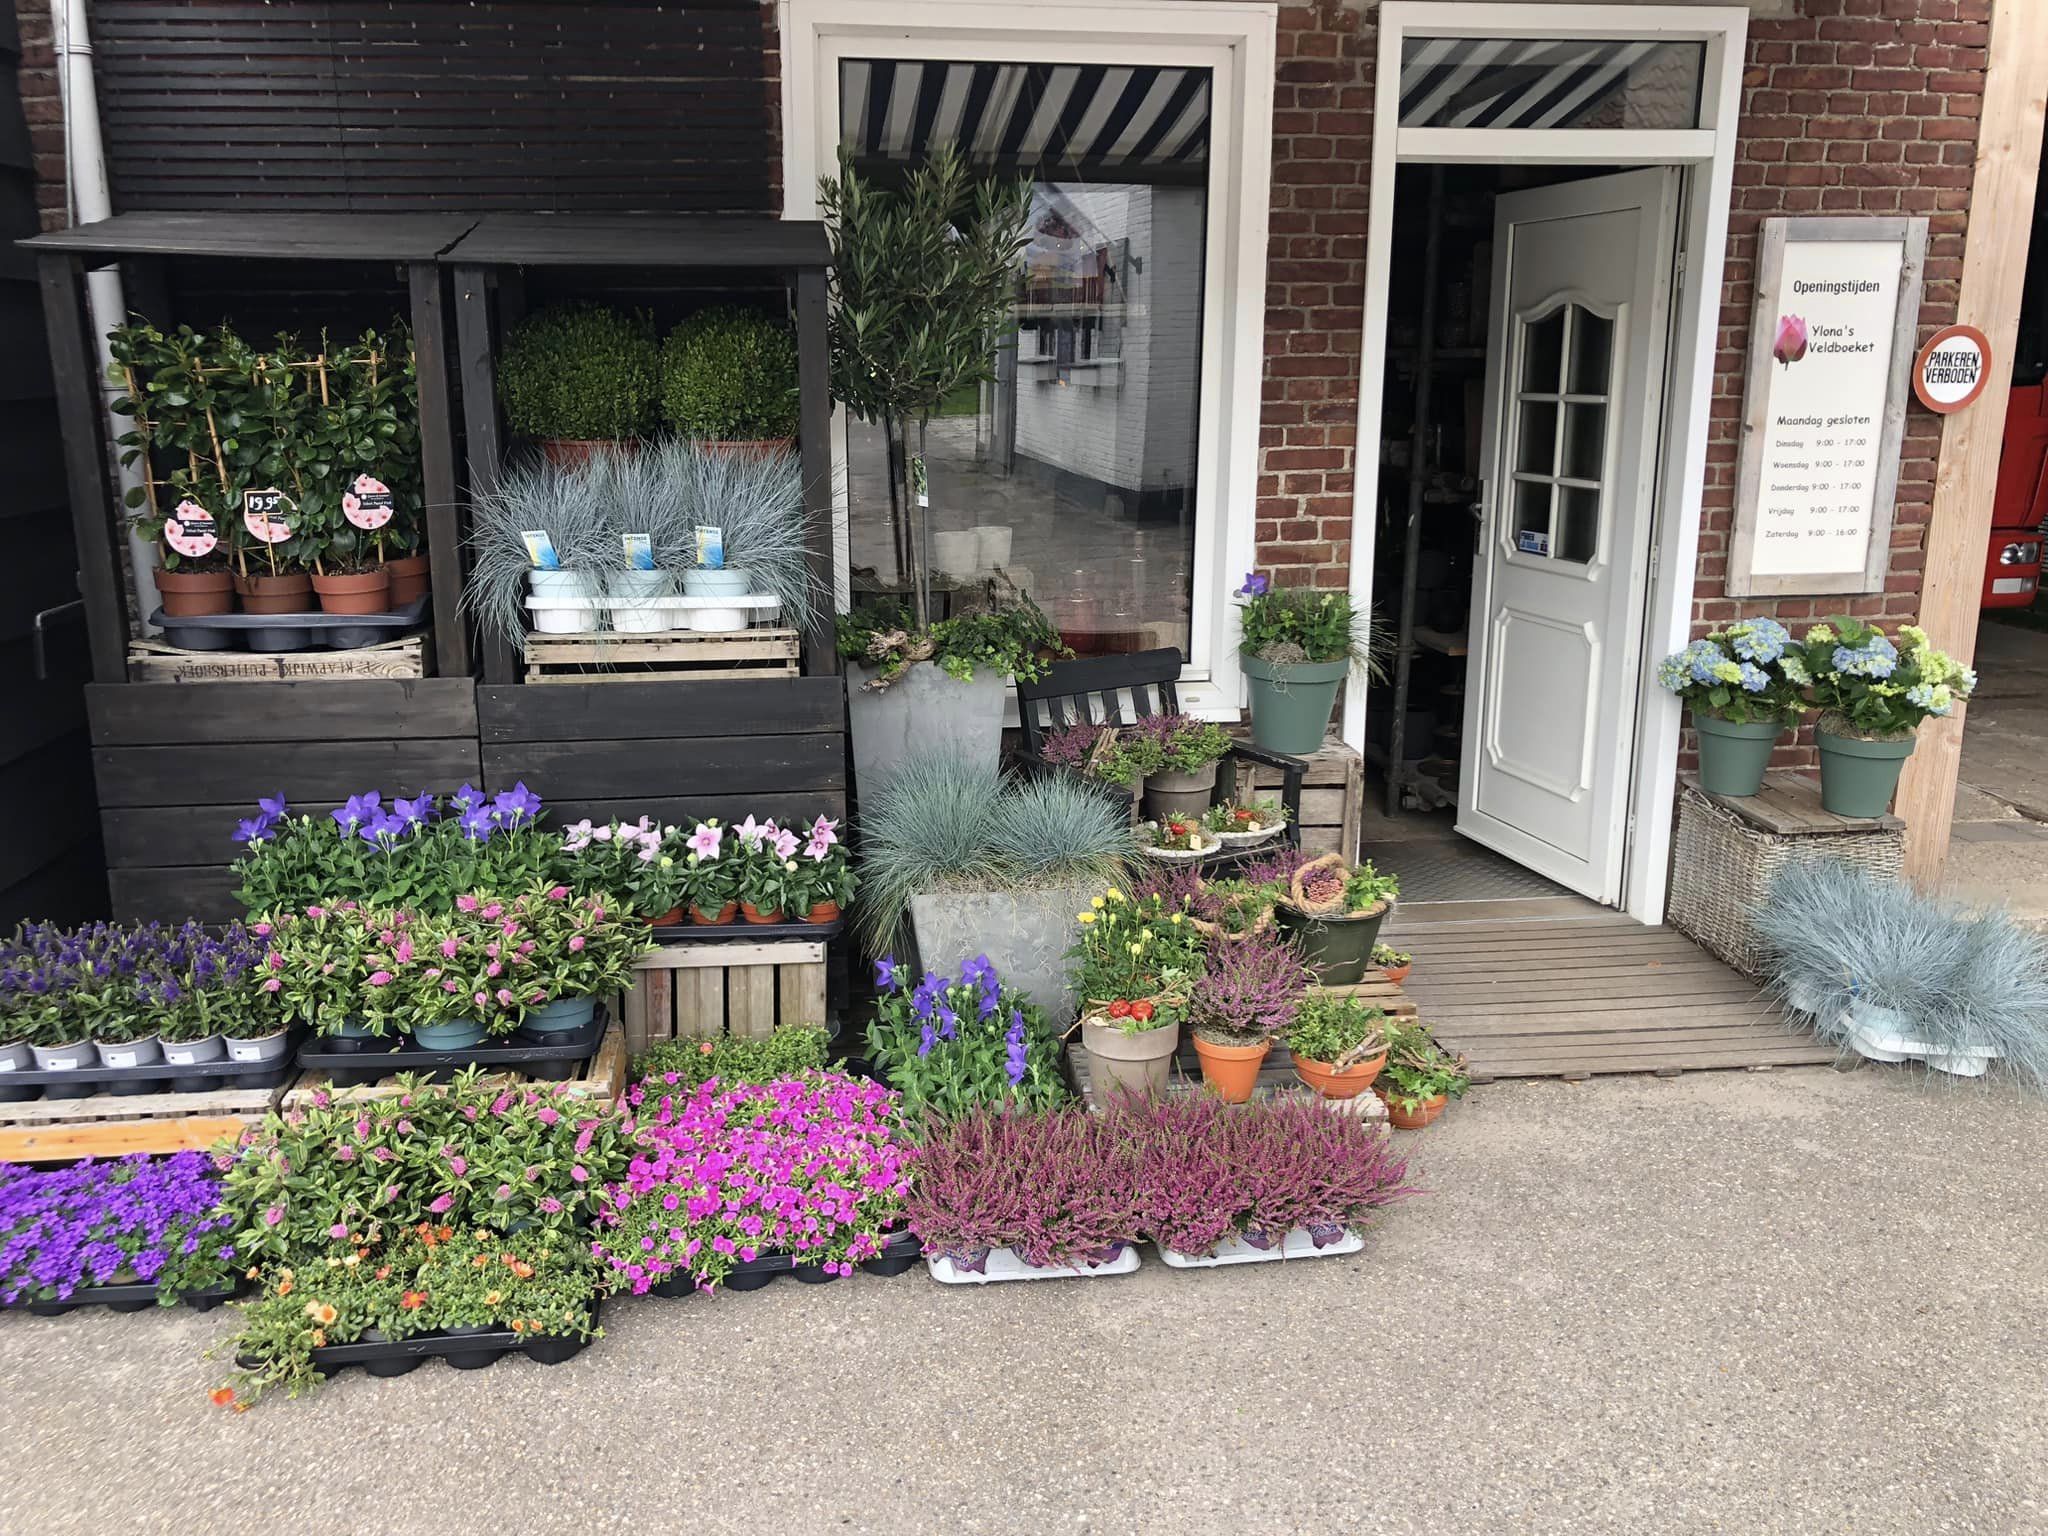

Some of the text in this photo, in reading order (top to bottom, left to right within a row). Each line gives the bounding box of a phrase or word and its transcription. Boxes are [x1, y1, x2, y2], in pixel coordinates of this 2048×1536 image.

[1793, 280, 1880, 295] Openingstijden
[1812, 325, 1855, 337] Ylona's
[1809, 341, 1875, 353] Veldboeket
[1928, 351, 1980, 367] PARKEREN
[1925, 368, 1977, 384] VERBODEN
[1777, 414, 1871, 428] Maandag gesloten
[1776, 440, 1804, 448] Dinsdag
[1816, 439, 1834, 447] 9:00
[1844, 438, 1867, 446] 17:00
[1773, 461, 1809, 470] Woensdag
[1815, 460, 1833, 468] 9:00
[1843, 459, 1865, 468] 17:00
[1770, 483, 1809, 492] Donderdag
[1811, 482, 1830, 490] 9:00
[1839, 482, 1862, 490] 17:00
[1768, 507, 1795, 516] Vrijdag
[1809, 506, 1828, 514] 9:00
[1838, 505, 1860, 513] 17:00
[1765, 530, 1799, 539] Zaterdag
